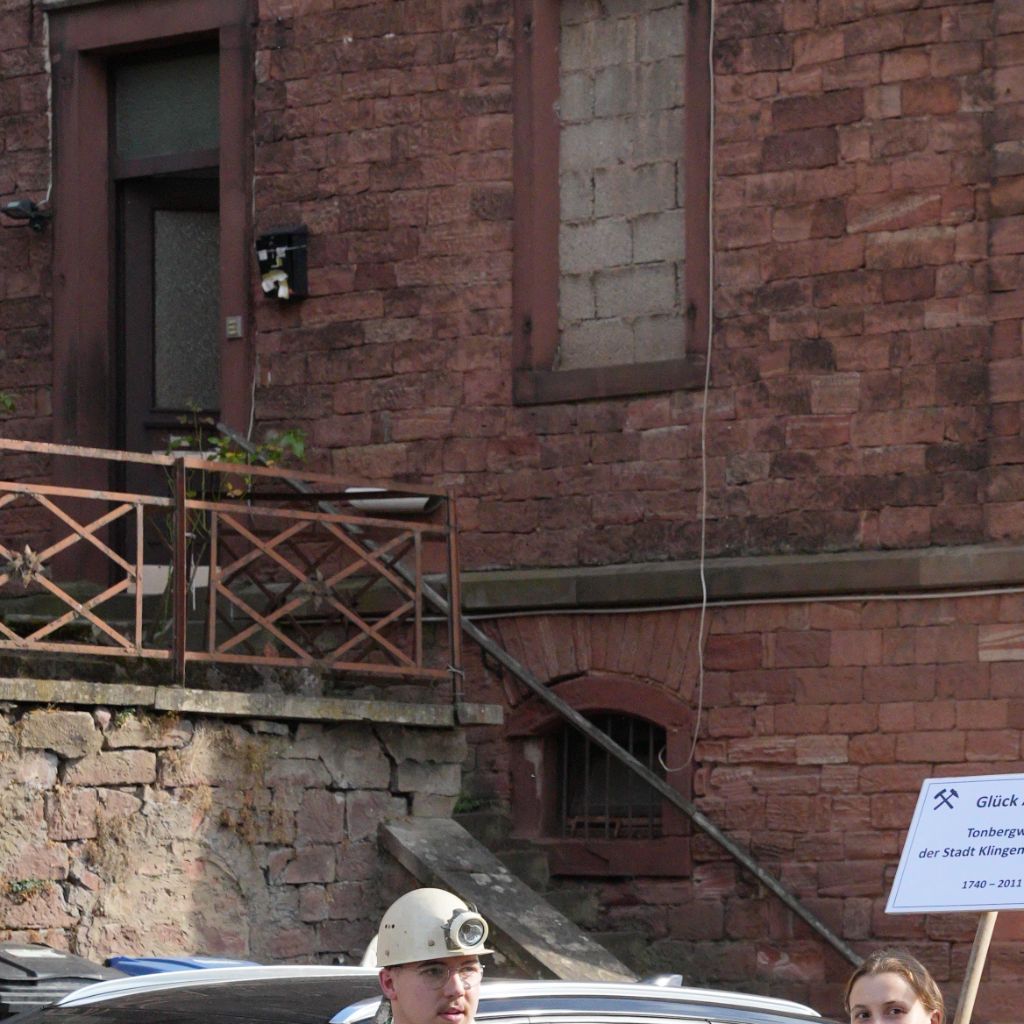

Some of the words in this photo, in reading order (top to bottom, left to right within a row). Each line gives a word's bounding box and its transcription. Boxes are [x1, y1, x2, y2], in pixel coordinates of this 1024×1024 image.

[976, 794, 1018, 809] Glück
[918, 847, 940, 859] der
[941, 846, 975, 858] Stadt
[961, 880, 987, 890] 1740
[997, 879, 1022, 889] 2011
